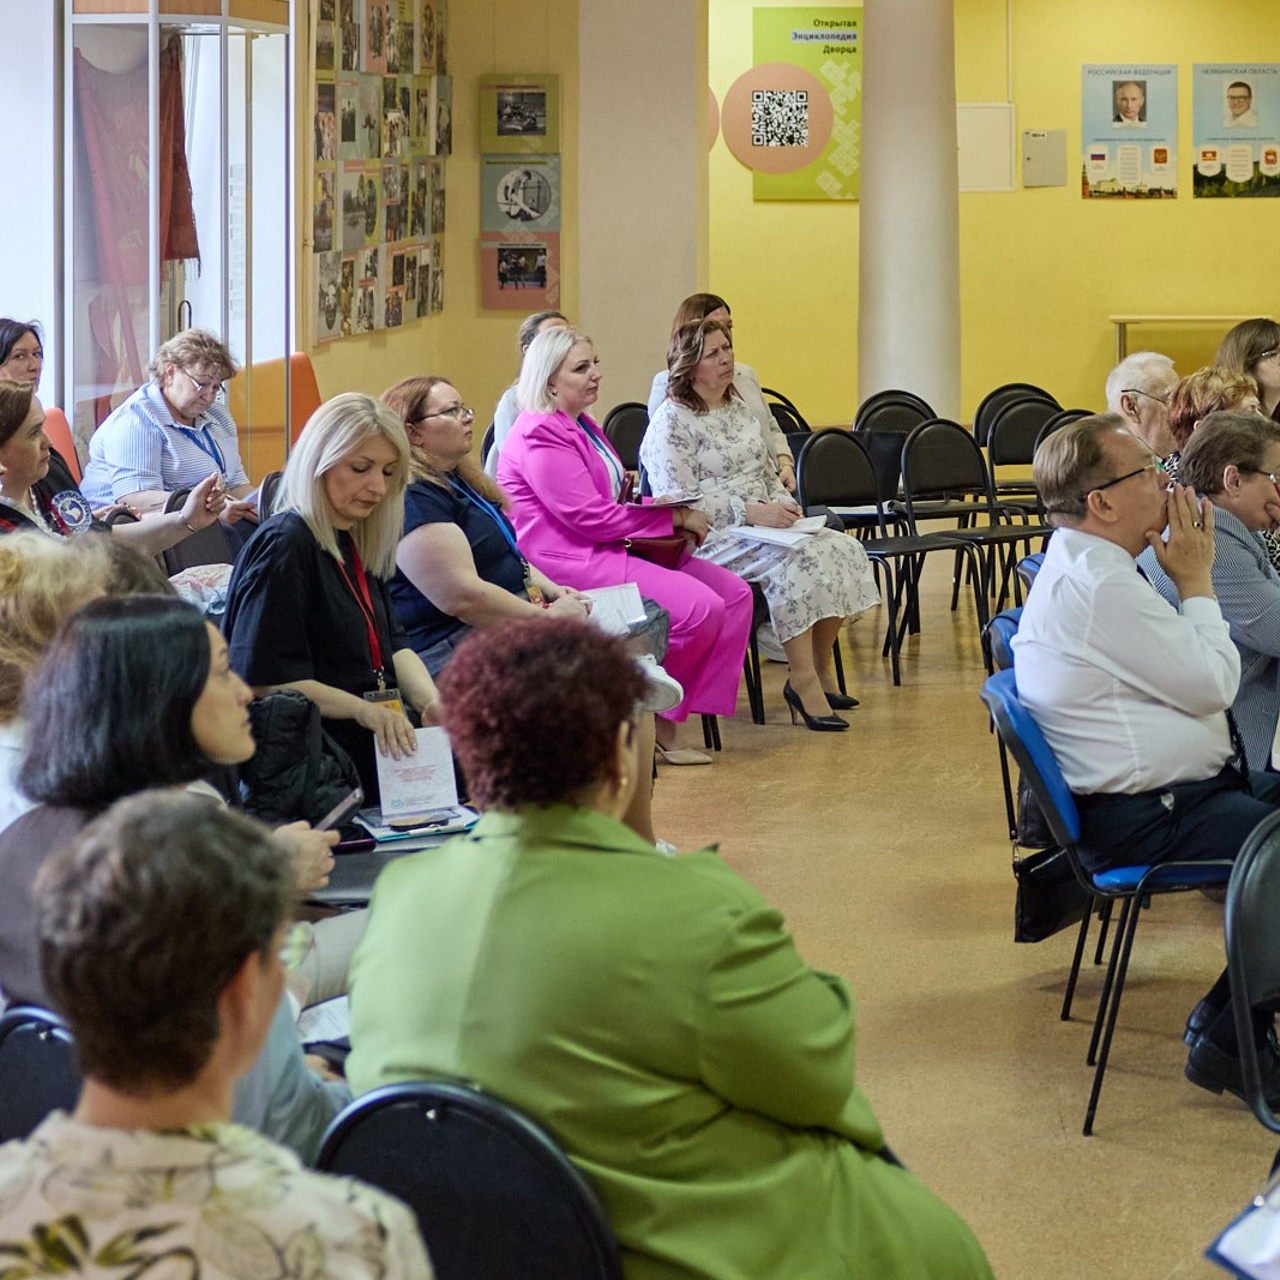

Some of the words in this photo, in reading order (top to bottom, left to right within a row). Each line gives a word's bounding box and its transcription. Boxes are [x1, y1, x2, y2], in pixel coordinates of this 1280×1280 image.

[813, 19, 857, 29] Открытая
[791, 31, 857, 41] Энциклопедия
[823, 45, 857, 55] Дворца
